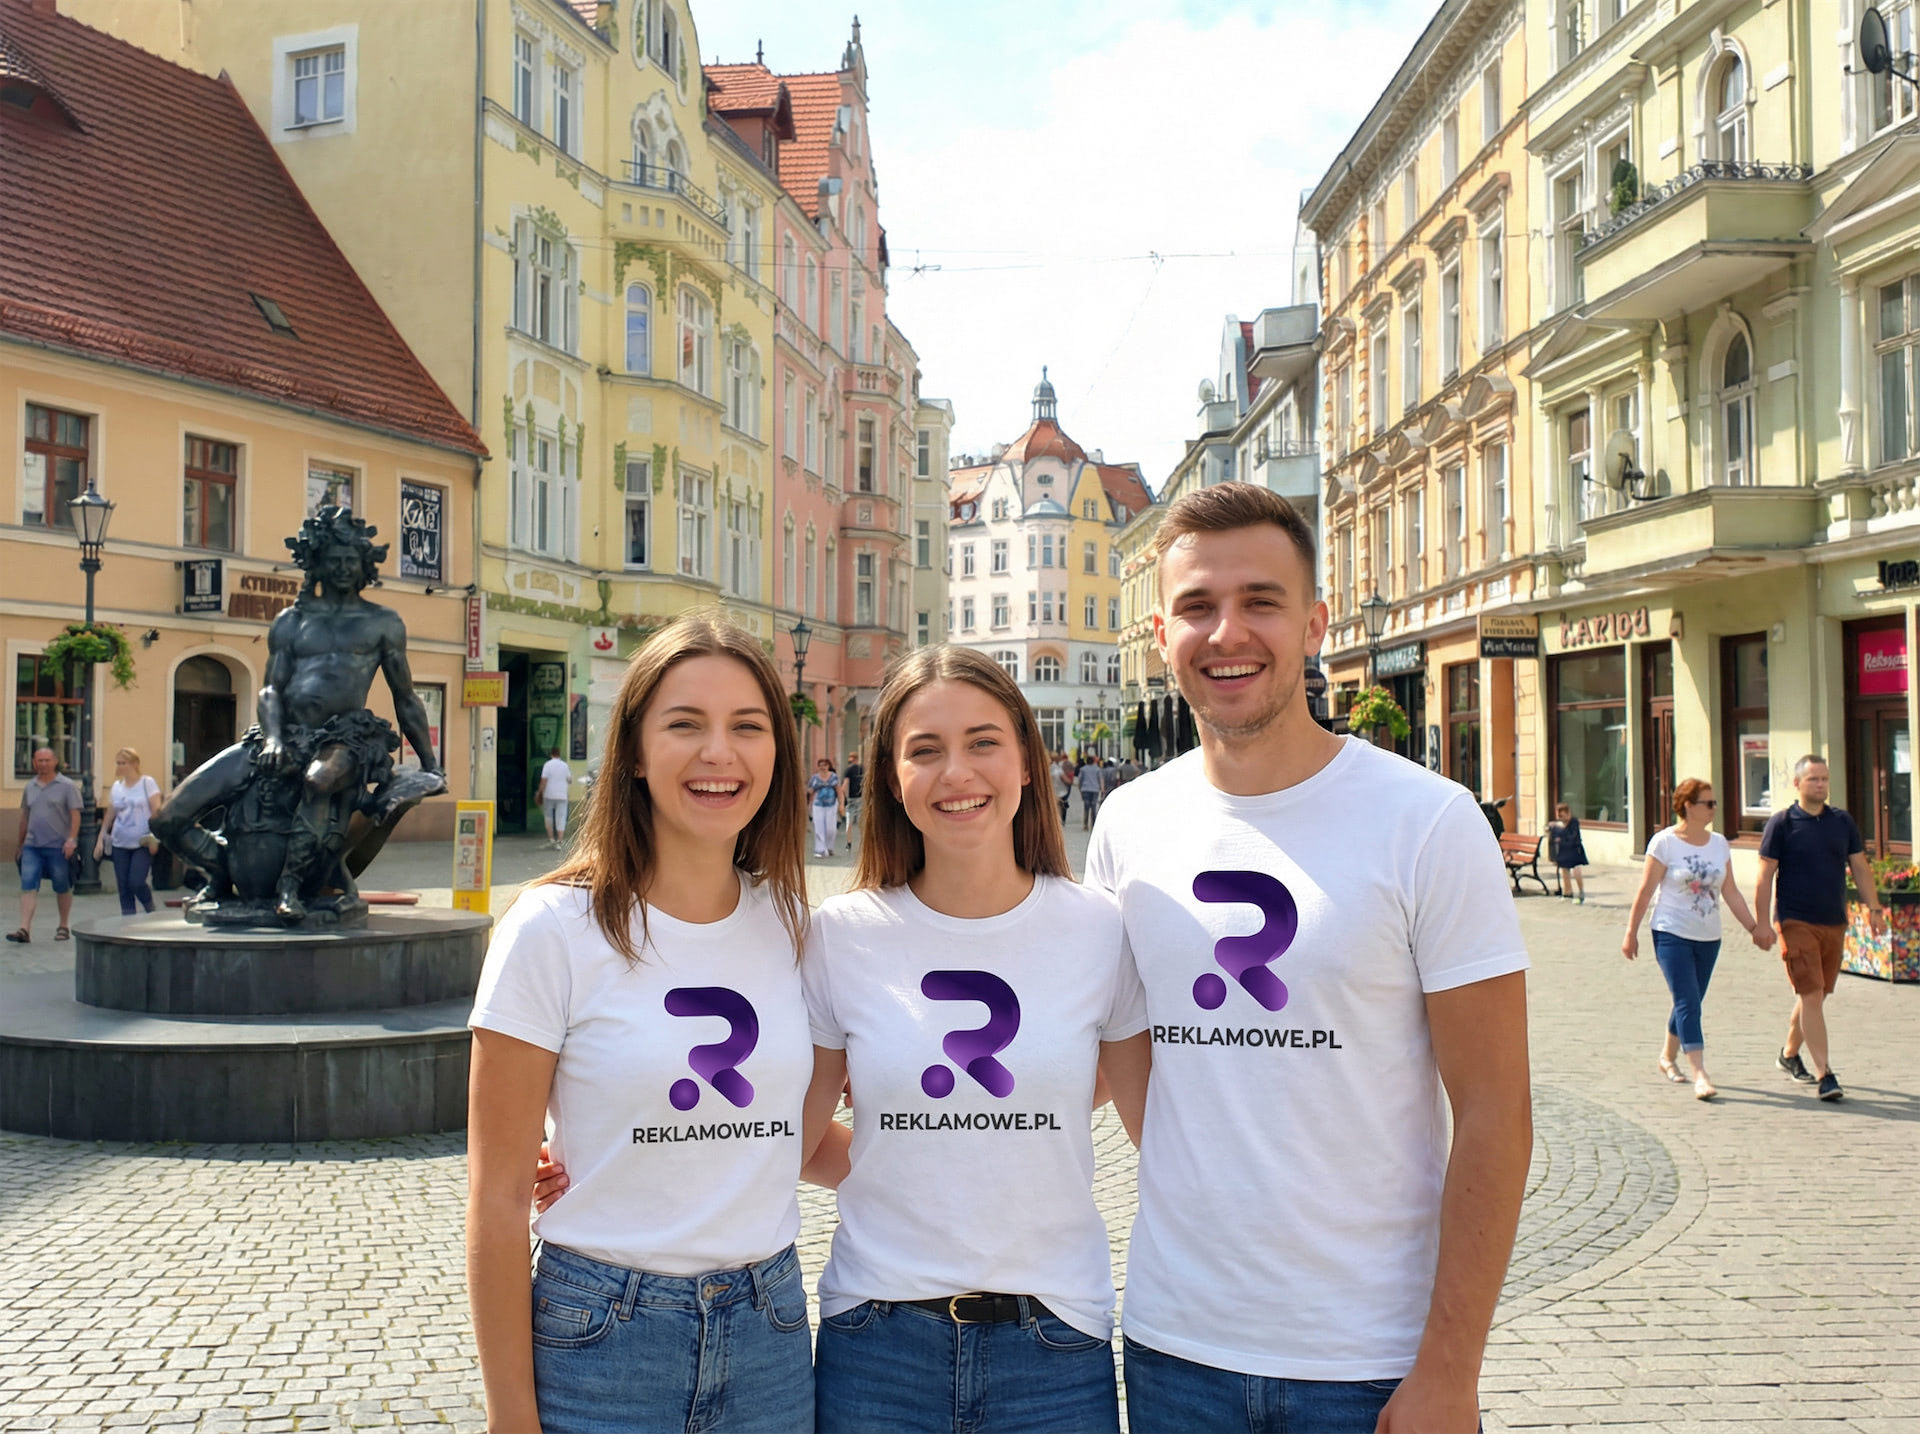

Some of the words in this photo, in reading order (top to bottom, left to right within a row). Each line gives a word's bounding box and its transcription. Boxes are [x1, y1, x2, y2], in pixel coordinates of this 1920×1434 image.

[1153, 1025, 1342, 1049] REKLAMOWE.PL
[632, 1120, 795, 1144] REKLAMOWE.PL
[880, 1113, 1061, 1131] REKLAMOWE.PL
